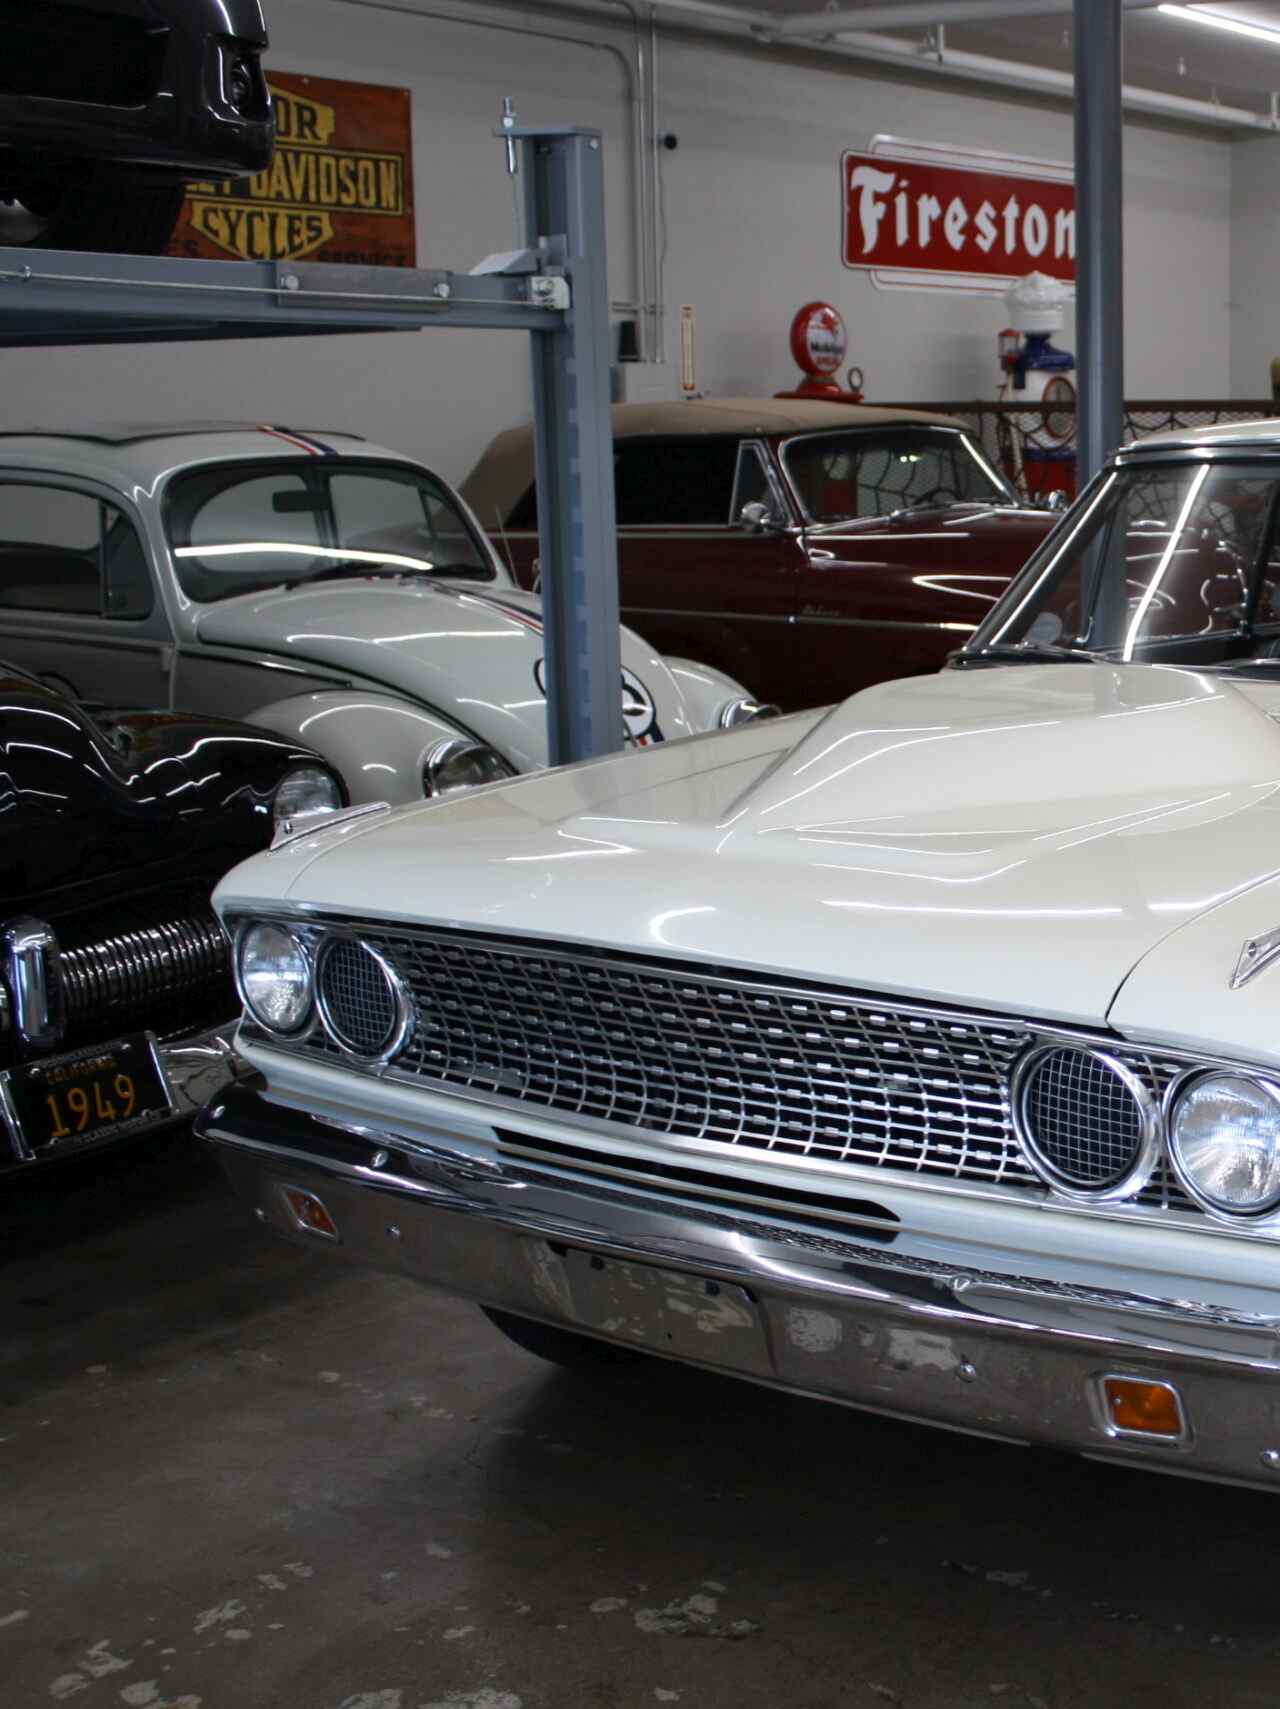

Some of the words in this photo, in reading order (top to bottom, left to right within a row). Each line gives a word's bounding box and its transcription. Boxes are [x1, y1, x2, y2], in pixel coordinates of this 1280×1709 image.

[203, 206, 323, 258] CYCLES
[851, 166, 1075, 259] Fireston
[47, 1073, 136, 1137] 1949
